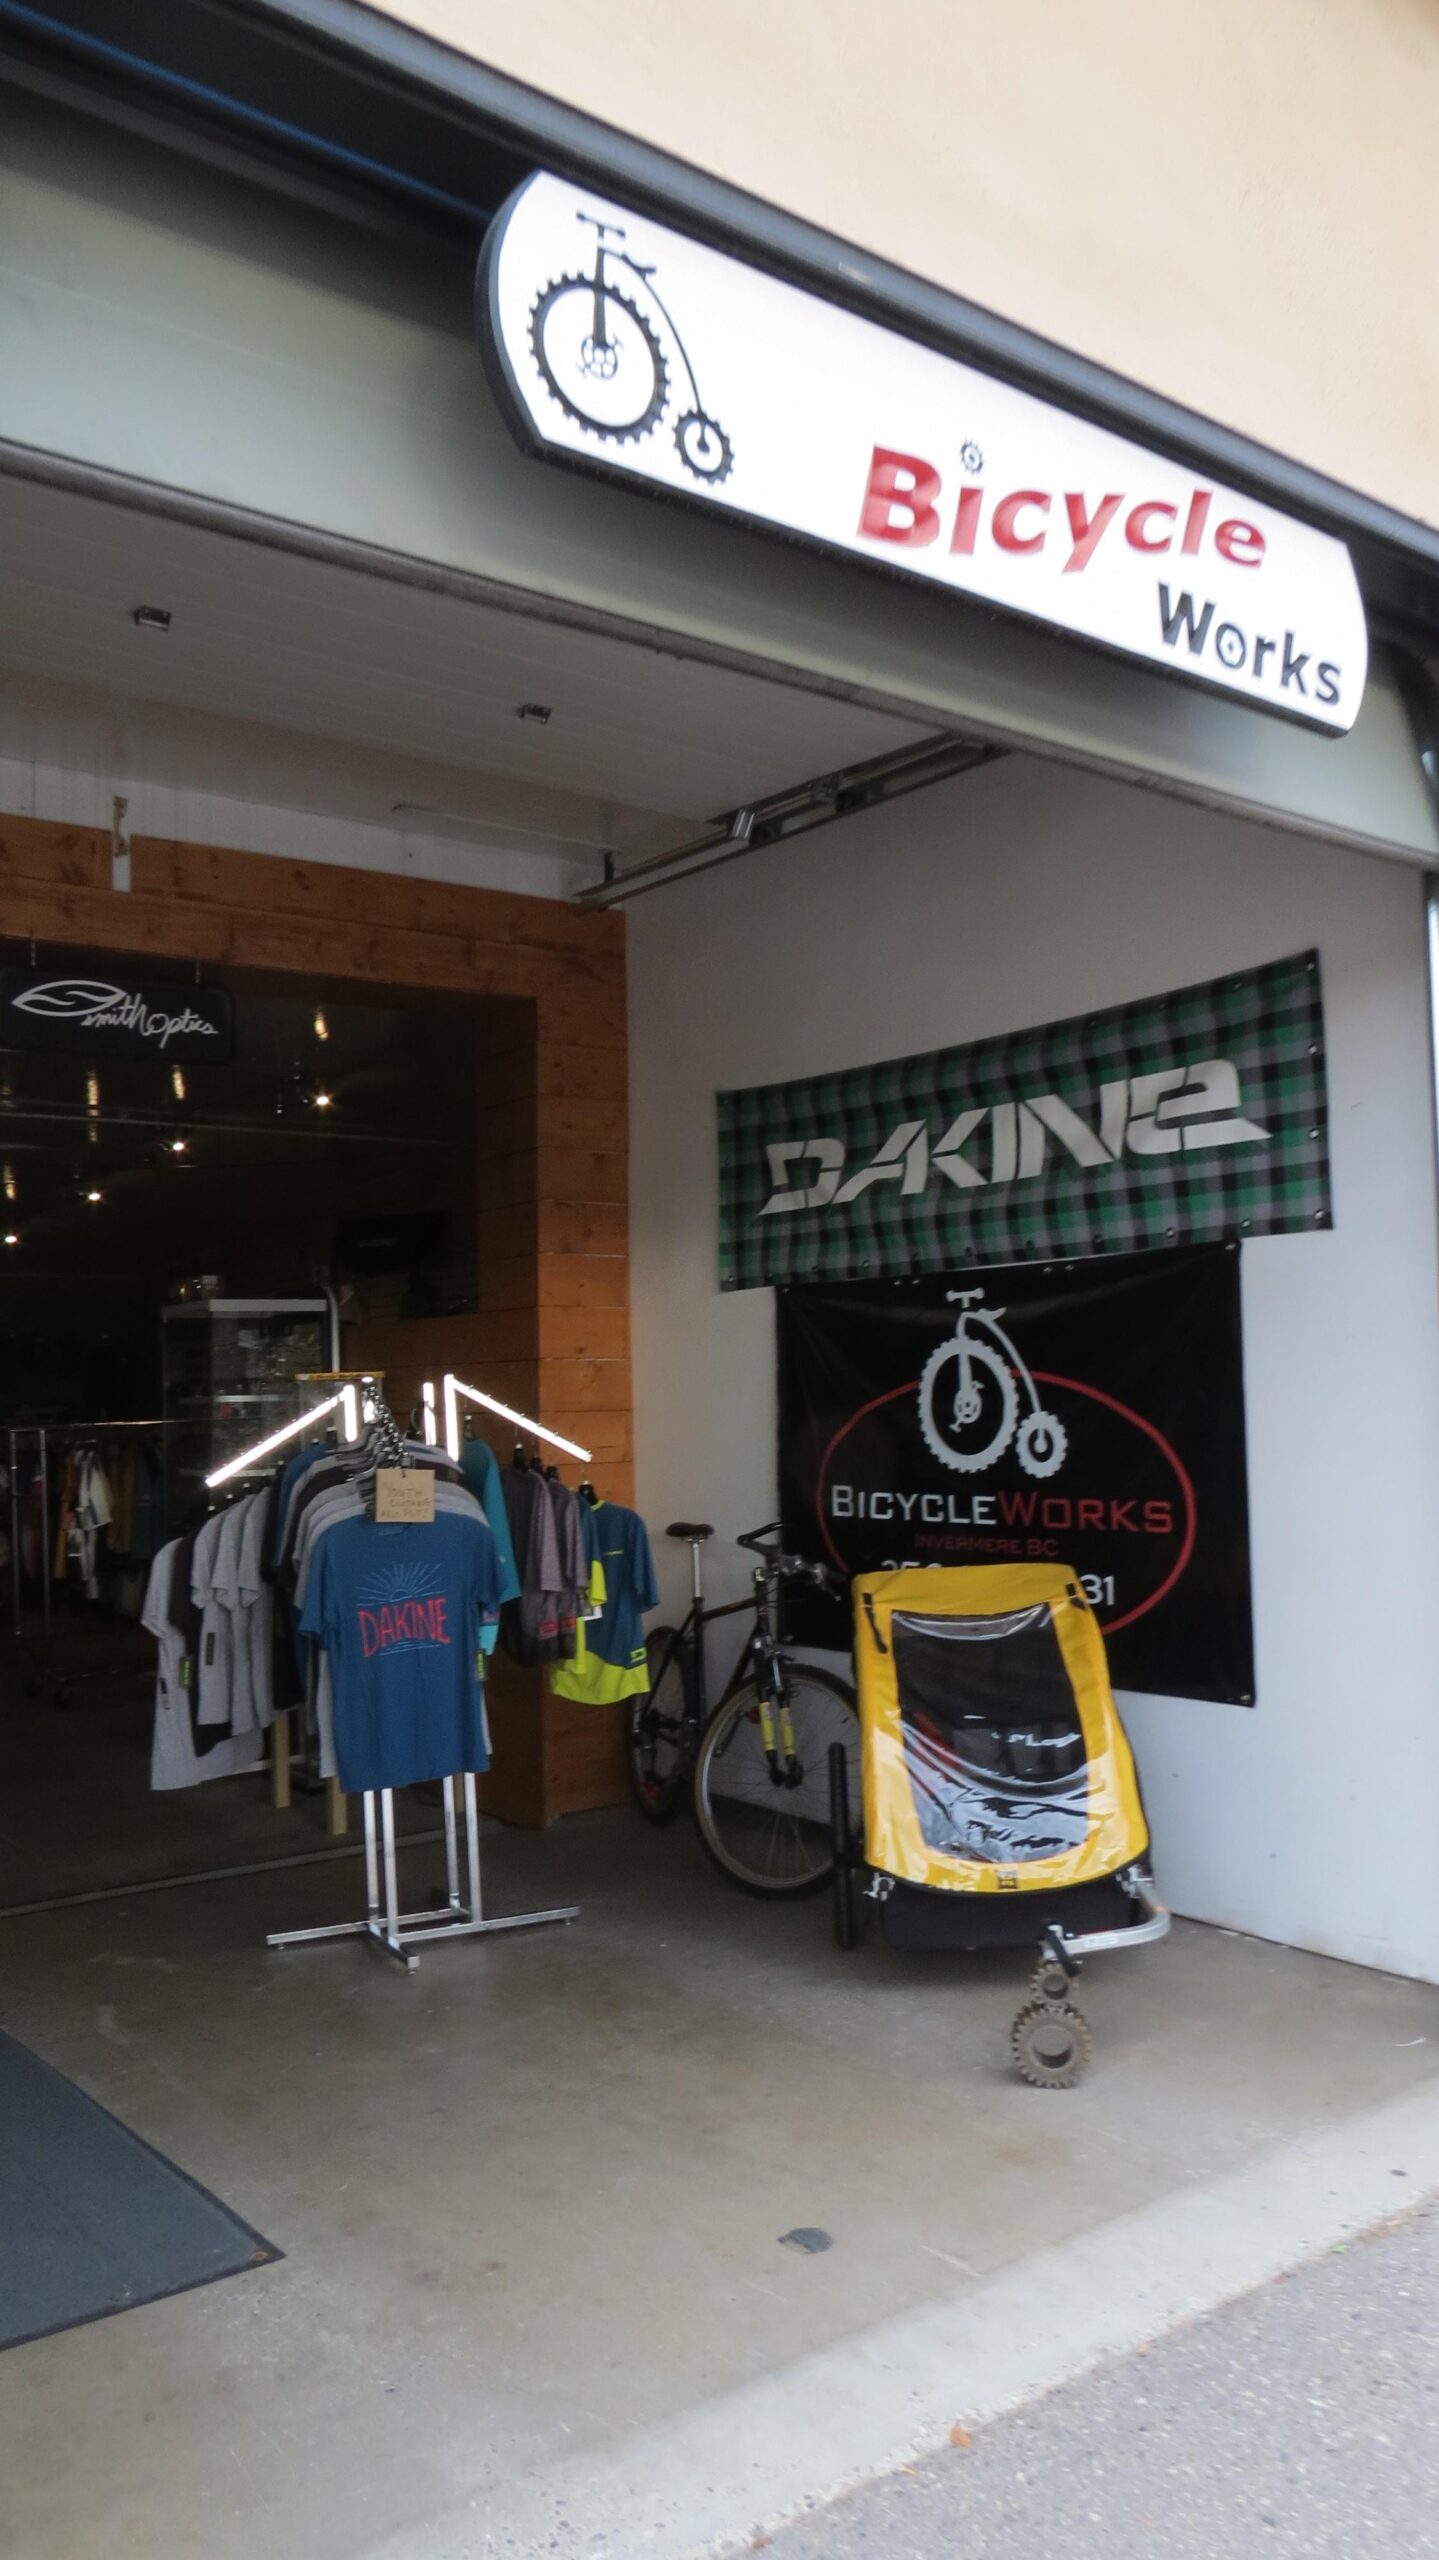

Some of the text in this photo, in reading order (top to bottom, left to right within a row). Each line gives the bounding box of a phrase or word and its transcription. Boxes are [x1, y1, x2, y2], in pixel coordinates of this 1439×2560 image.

[857, 441, 1267, 573] Bicycle
[1158, 582, 1343, 706] Works
[760, 1058, 1273, 1216] DAKINE
[1027, 1538, 1059, 1556] BC
[357, 1597, 450, 1657] DAKINE
